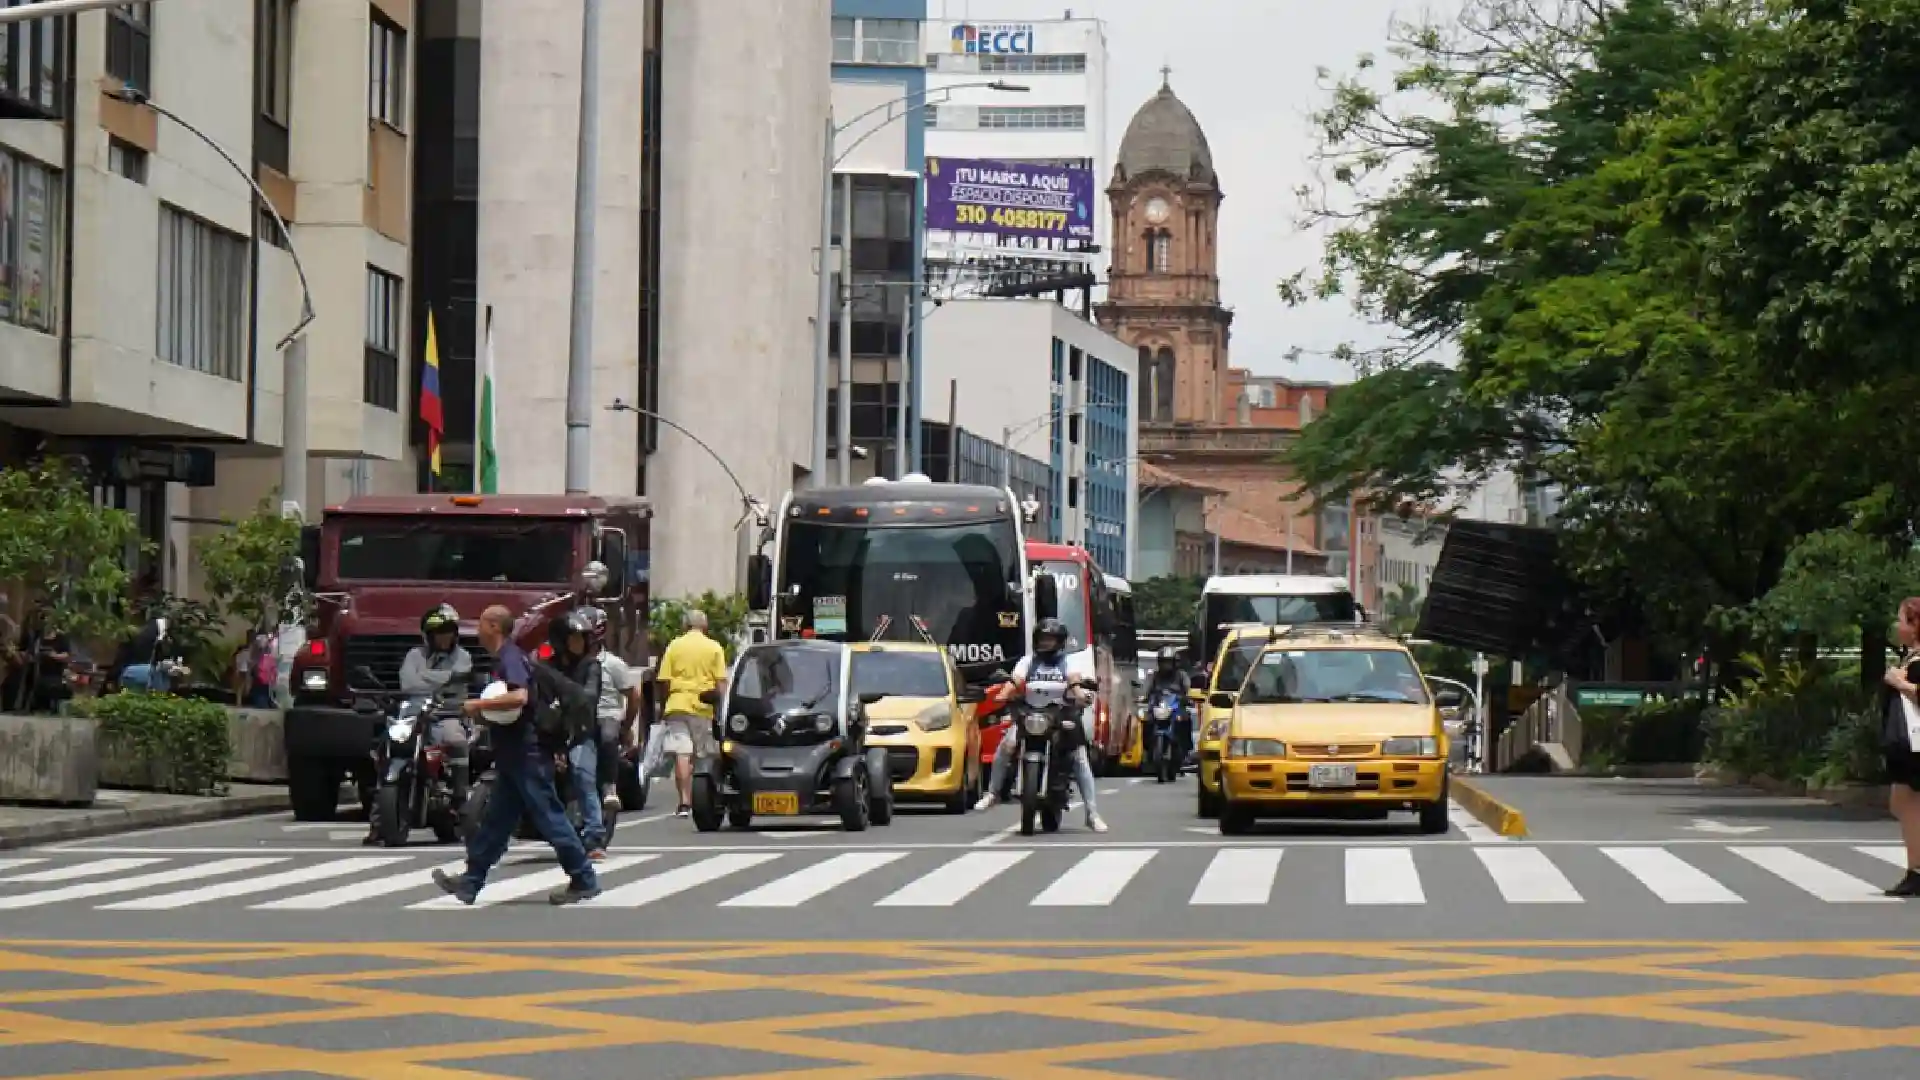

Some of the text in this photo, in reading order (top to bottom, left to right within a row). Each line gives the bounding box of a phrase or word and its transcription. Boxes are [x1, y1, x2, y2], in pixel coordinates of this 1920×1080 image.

[979, 31, 1033, 53] ECCI
[980, 171, 1027, 185] MARCA
[955, 204, 987, 223] 310
[992, 208, 1067, 231] 4058177
